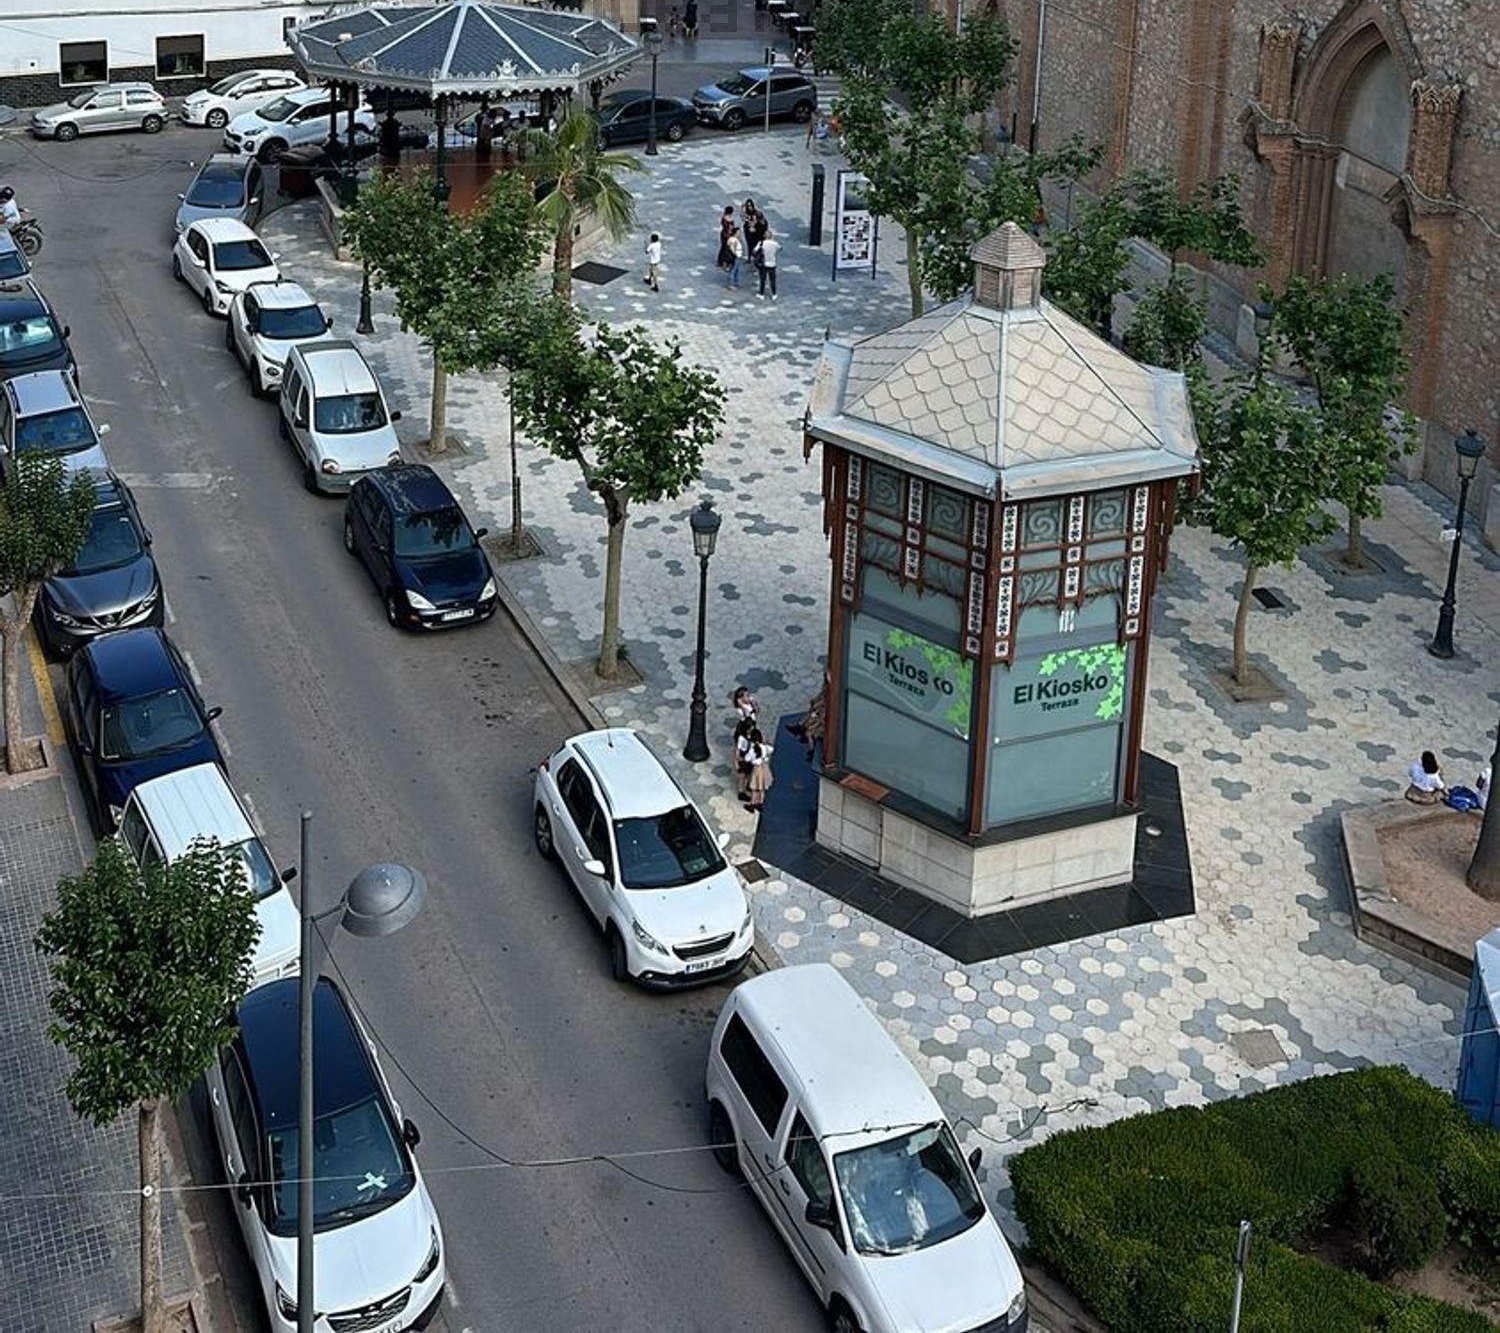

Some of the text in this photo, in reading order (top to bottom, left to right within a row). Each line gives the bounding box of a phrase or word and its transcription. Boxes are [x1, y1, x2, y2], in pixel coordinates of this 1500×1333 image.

[863, 641, 882, 666] El
[888, 673, 926, 697] Terraza
[1013, 672, 1108, 705] El Kiosko
[1040, 698, 1079, 712] Terraza
